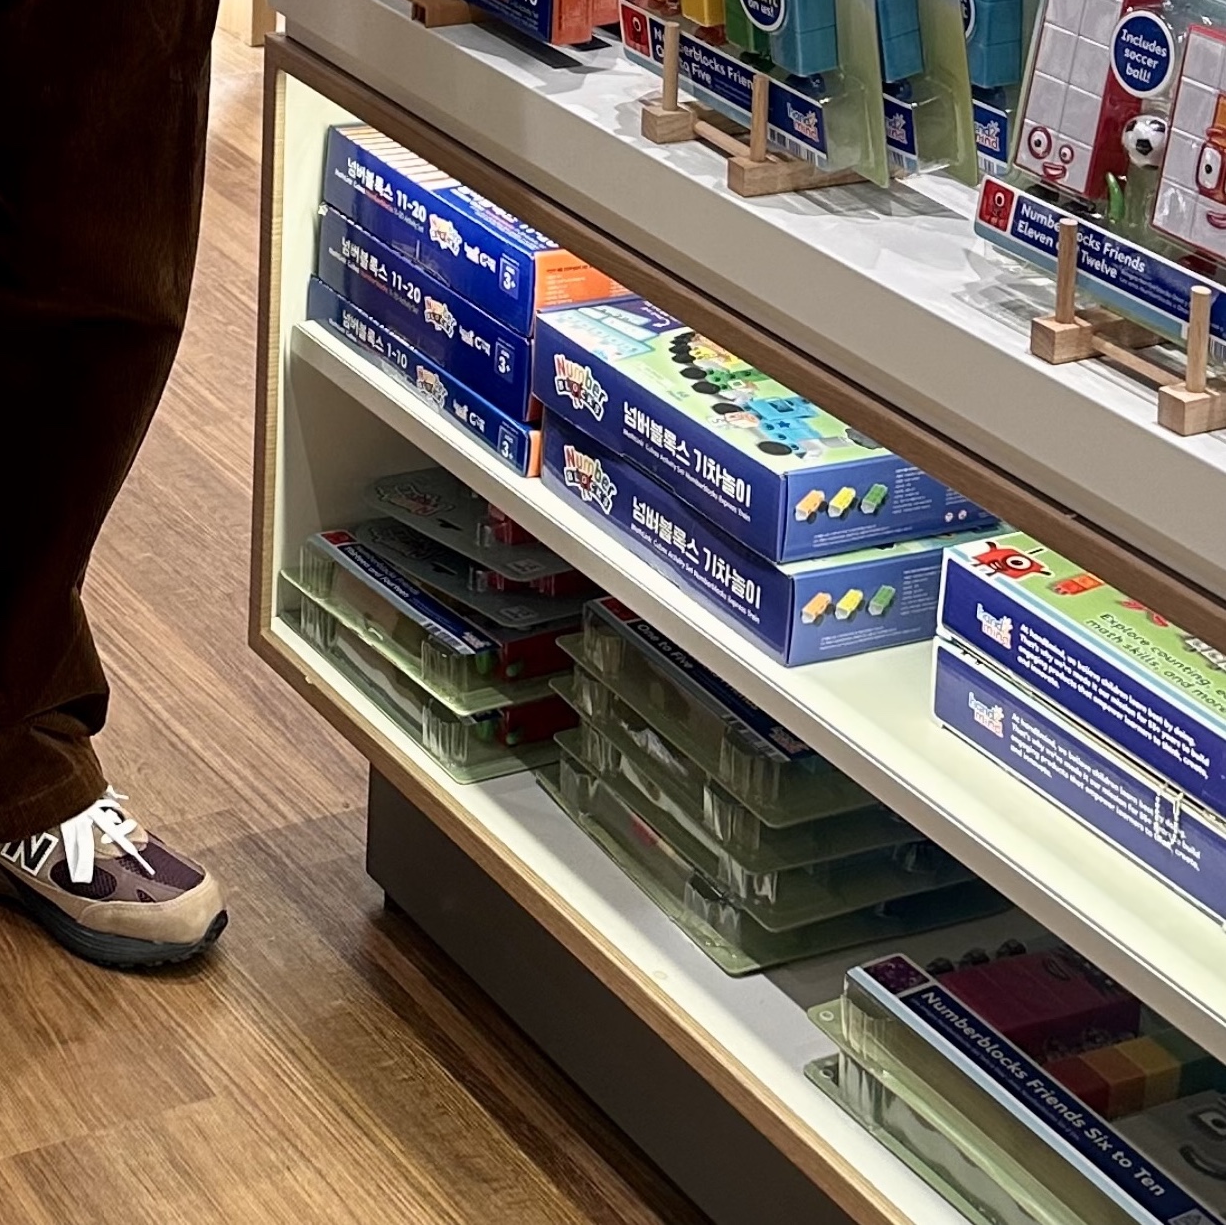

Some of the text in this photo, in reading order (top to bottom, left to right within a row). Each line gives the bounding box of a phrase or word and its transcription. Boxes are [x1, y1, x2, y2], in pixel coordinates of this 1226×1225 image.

[1120, 28, 1168, 58] Includes
[1123, 47, 1160, 70] soccer
[691, 63, 713, 85] Five
[727, 65, 754, 90] Frien
[1125, 62, 1152, 84] ball!
[395, 188, 427, 223] 11-20
[1016, 220, 1118, 279] Eleven Twelve
[1020, 202, 1146, 274] Numbeocks Friends
[390, 269, 422, 304] 11-20
[502, 271, 517, 290] 3+
[386, 342, 408, 370] 1-10
[497, 354, 511, 374] 3+
[554, 354, 609, 404] Number
[501, 440, 514, 460] 3+
[623, 401, 752, 508] 넘버블록스 기차놀이
[564, 445, 618, 495] Number
[631, 495, 761, 610] 넘버블록스 기차놀이
[637, 623, 695, 670] One to Five
[1099, 613, 1150, 647] Explore
[1085, 618, 1123, 644] math
[1123, 641, 1160, 671] skills,
[1163, 669, 1196, 693] and
[1, 832, 59, 876] N
[920, 990, 1167, 1198] Numberblocks Friends Six to Ten
